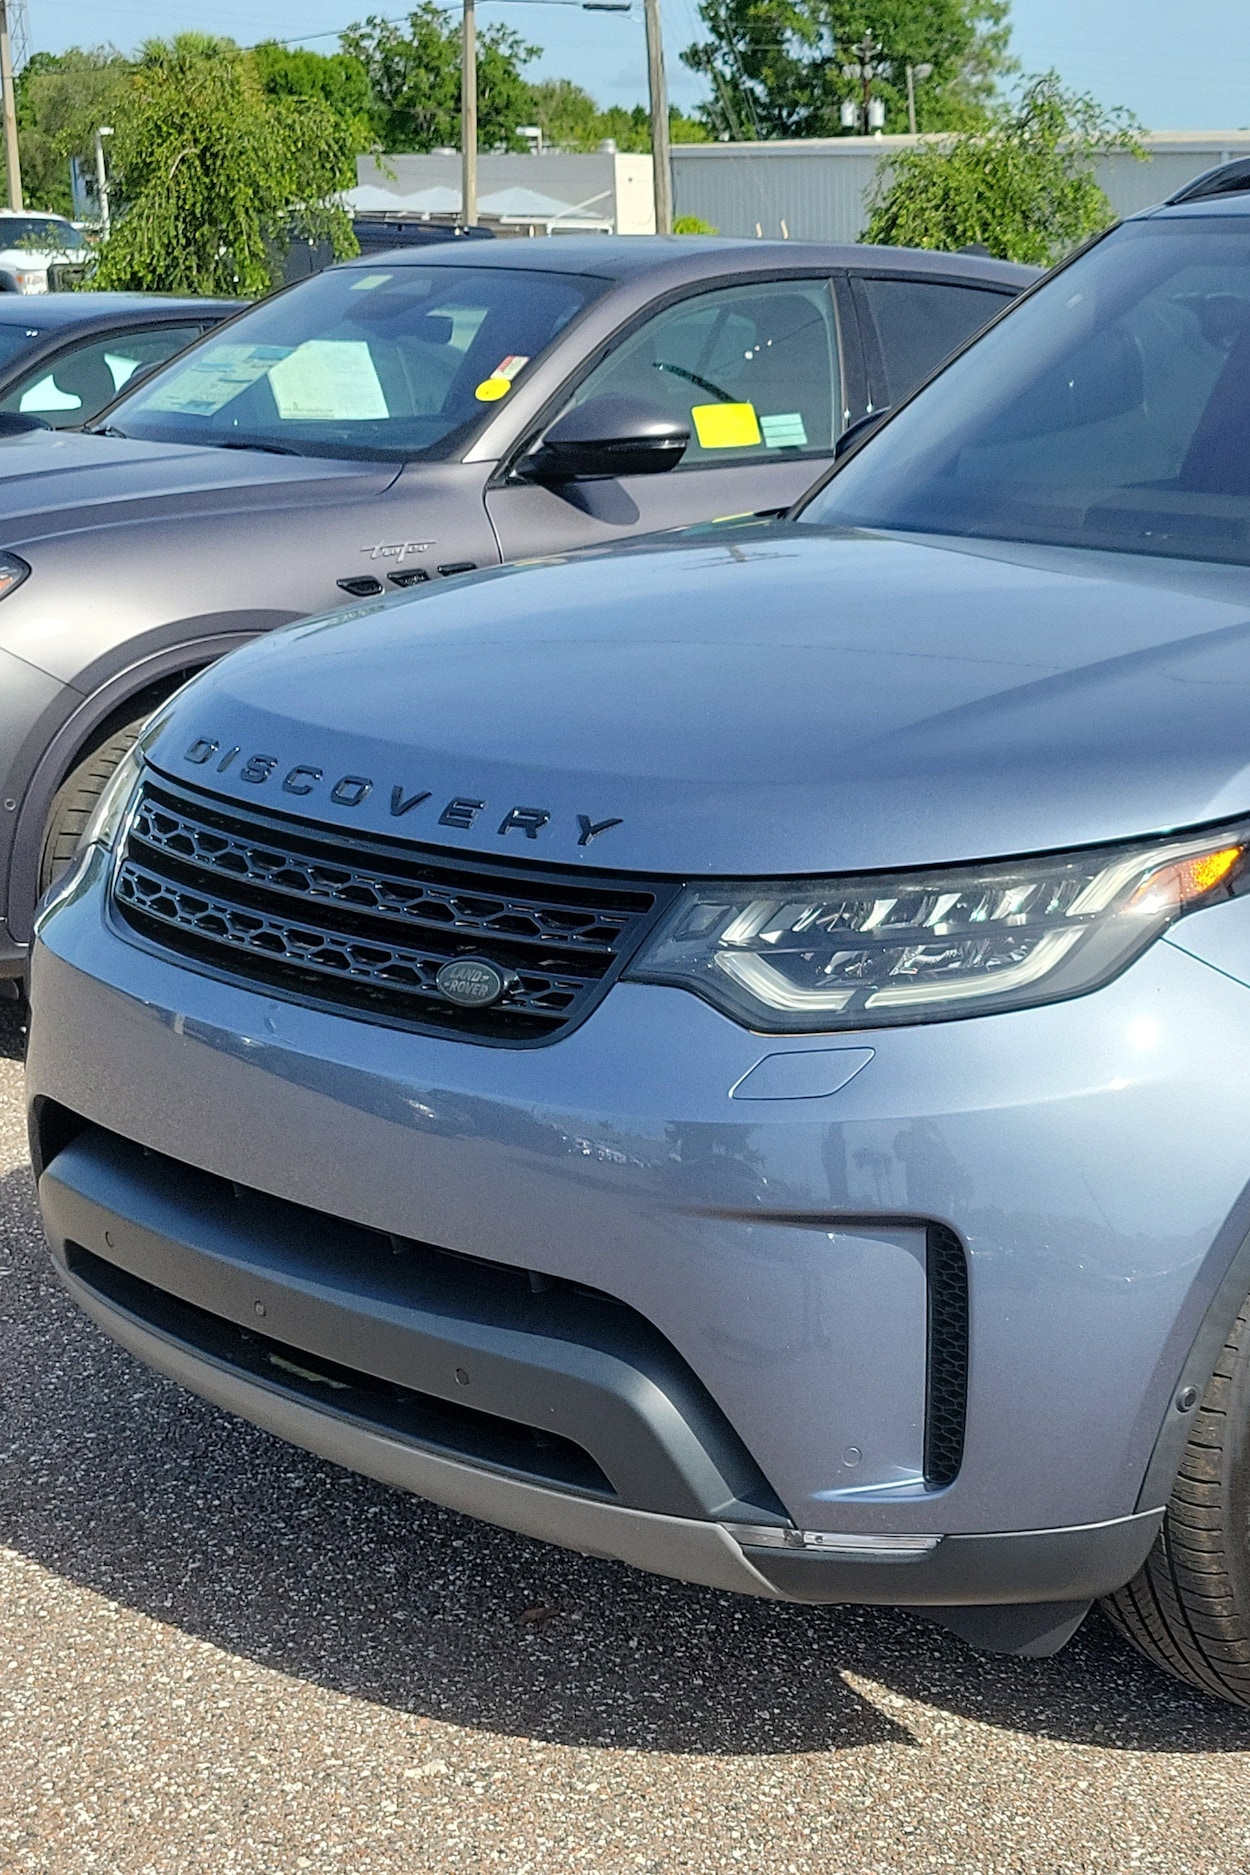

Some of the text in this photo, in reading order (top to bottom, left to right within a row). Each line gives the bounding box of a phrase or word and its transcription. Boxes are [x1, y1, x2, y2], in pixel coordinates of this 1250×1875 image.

[183, 736, 624, 846] DISCOVERY
[450, 967, 483, 982] LAND
[449, 980, 489, 997] ROVER
